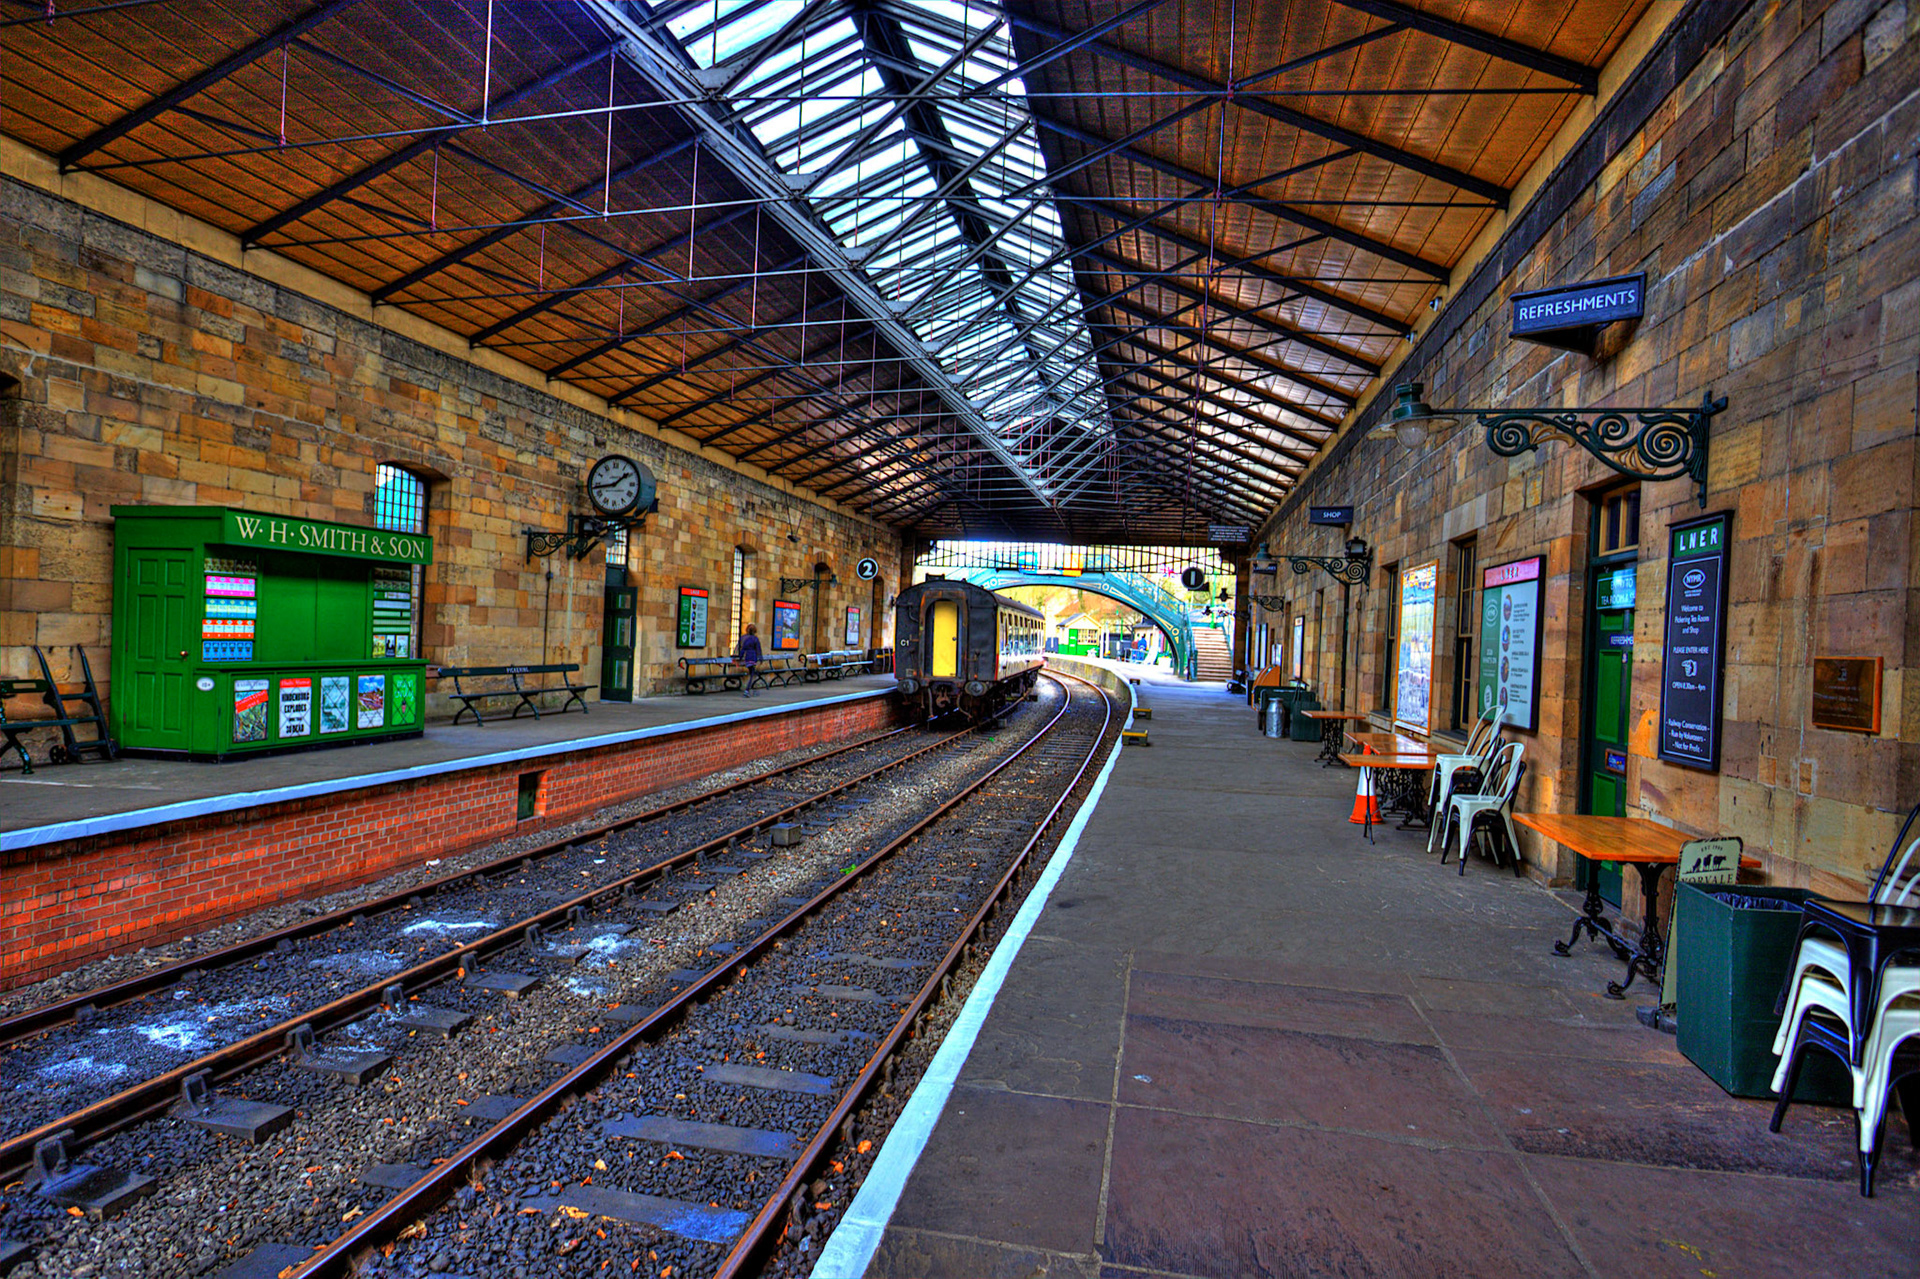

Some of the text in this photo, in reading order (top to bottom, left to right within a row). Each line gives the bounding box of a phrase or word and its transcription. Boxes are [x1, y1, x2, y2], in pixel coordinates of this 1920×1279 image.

[1520, 290, 1636, 320] REFRESHMENTS
[299, 524, 366, 554] SMITH
[370, 536, 386, 556] &
[389, 537, 425, 560] SON
[1680, 527, 1718, 552] LNER
[862, 562, 873, 576] 2
[1500, 567, 1519, 580] LNER
[1686, 574, 1702, 584] NYMR
[1601, 595, 1609, 606] TEA
[1674, 616, 1690, 624] Pickering
[1690, 626, 1699, 635] Shop
[282, 692, 309, 702] HINDENBURG
[284, 704, 306, 714] EXPLODES
[292, 724, 304, 733] DEAD
[1668, 718, 1707, 731] Railway Conservation
[1679, 731, 1684, 740] by
[1683, 732, 1704, 742] Volunteers
[1689, 743, 1700, 752] Profit
